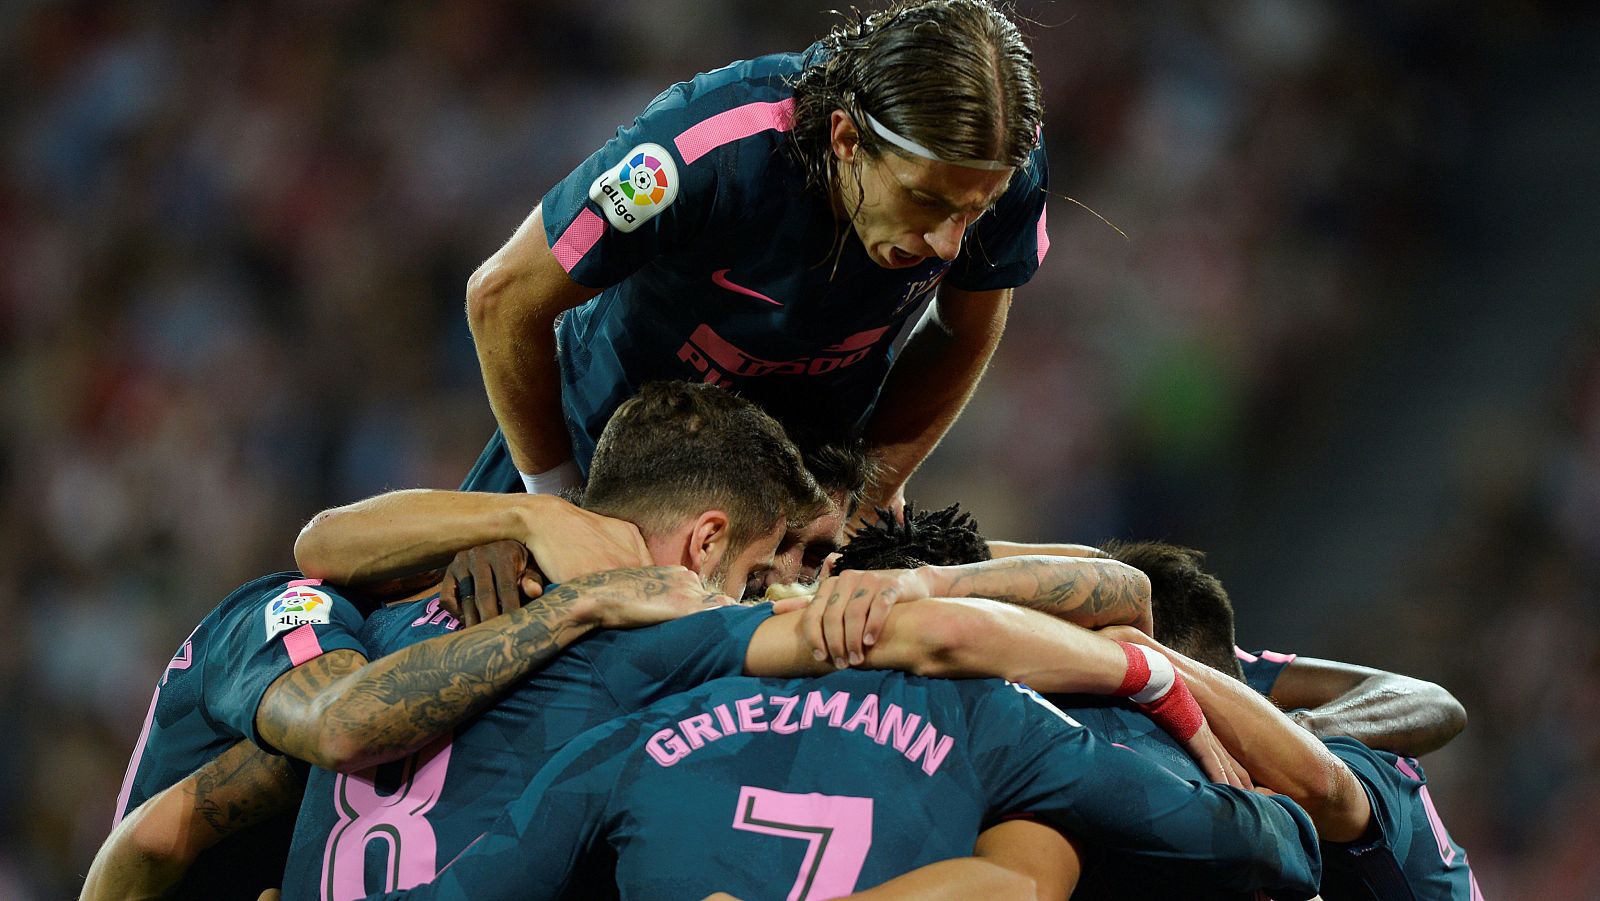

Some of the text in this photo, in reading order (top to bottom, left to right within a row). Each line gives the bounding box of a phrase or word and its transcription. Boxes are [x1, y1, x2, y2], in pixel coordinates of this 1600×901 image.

[599, 177, 636, 224] LaLiga
[645, 690, 955, 777] GRIEZMANN
[320, 733, 453, 901] 8
[732, 785, 874, 901] 7
